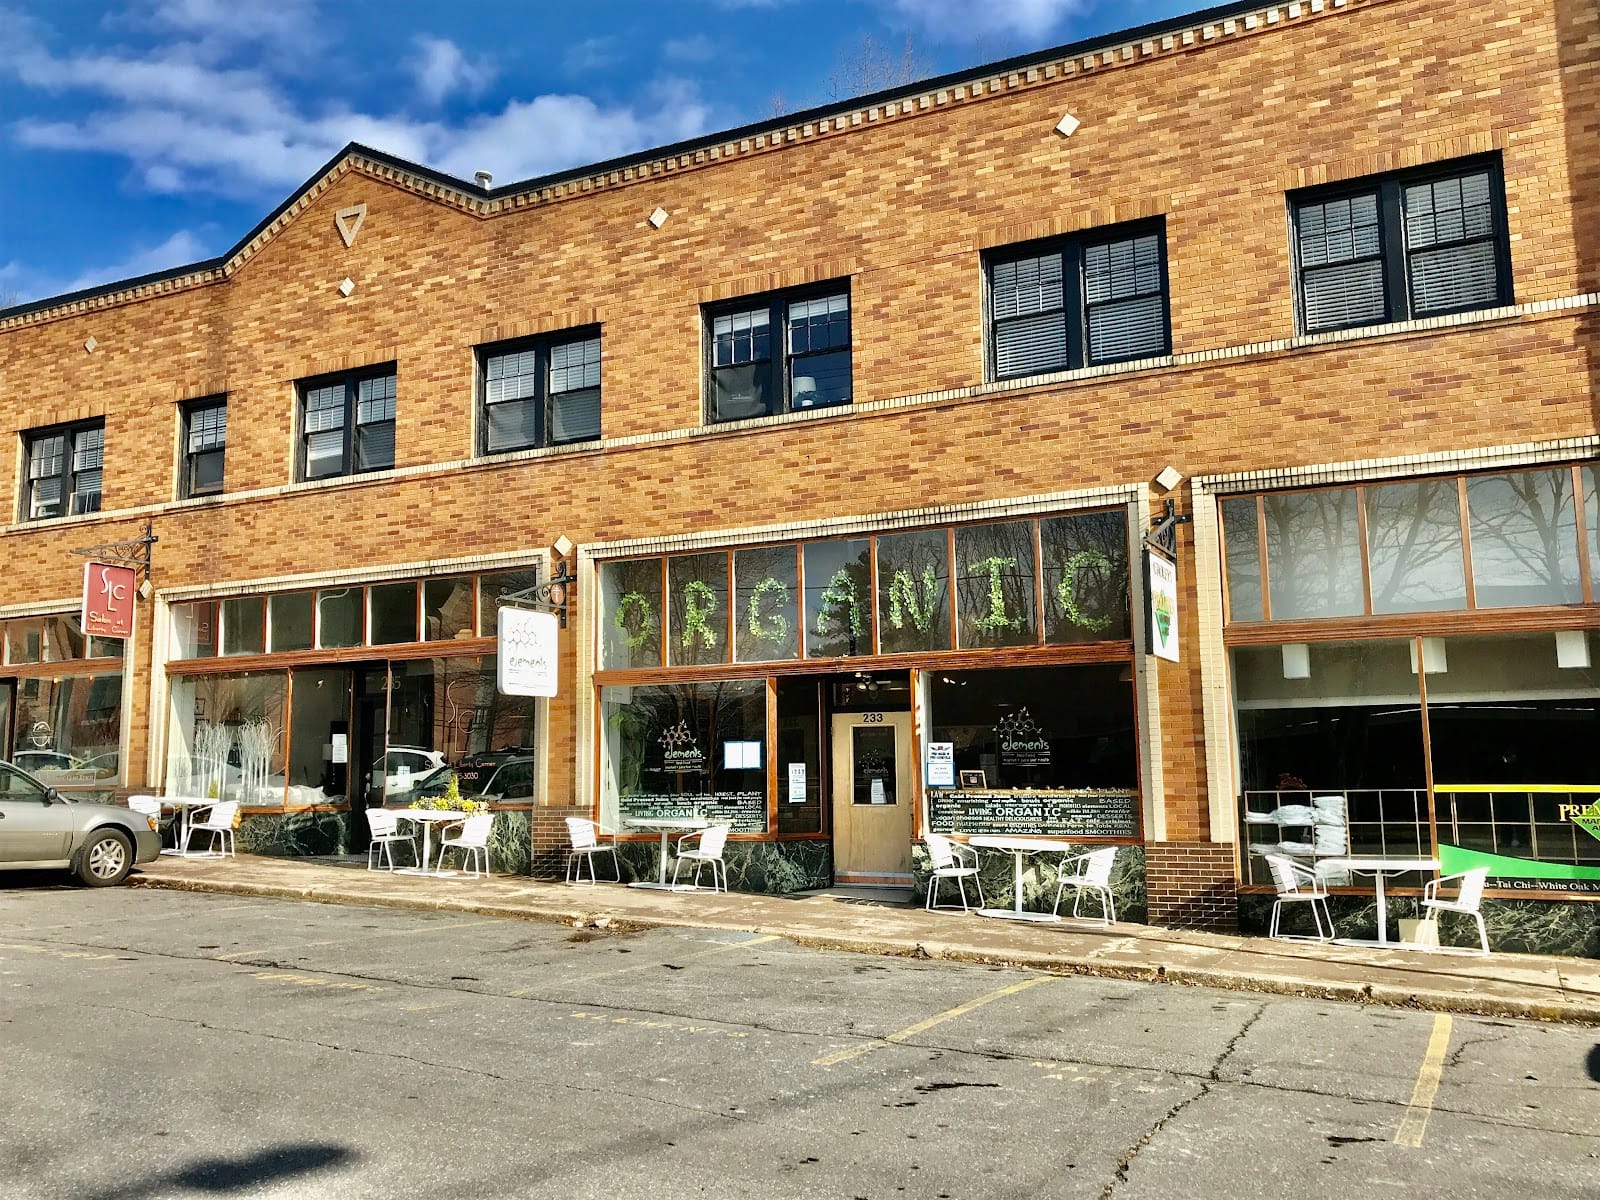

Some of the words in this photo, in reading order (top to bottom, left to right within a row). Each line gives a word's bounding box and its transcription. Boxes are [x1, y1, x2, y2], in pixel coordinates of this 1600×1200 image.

[614, 549, 1113, 650] ORGANIC
[89, 611, 112, 624] Salon
[863, 713, 884, 723] 233
[1002, 736, 1050, 752] elements
[664, 746, 703, 760] elements
[656, 807, 709, 818] ORGANIC
[968, 808, 993, 816] LIVING
[995, 807, 1062, 816] ORGANIC
[1569, 884, 1590, 892] Oak
